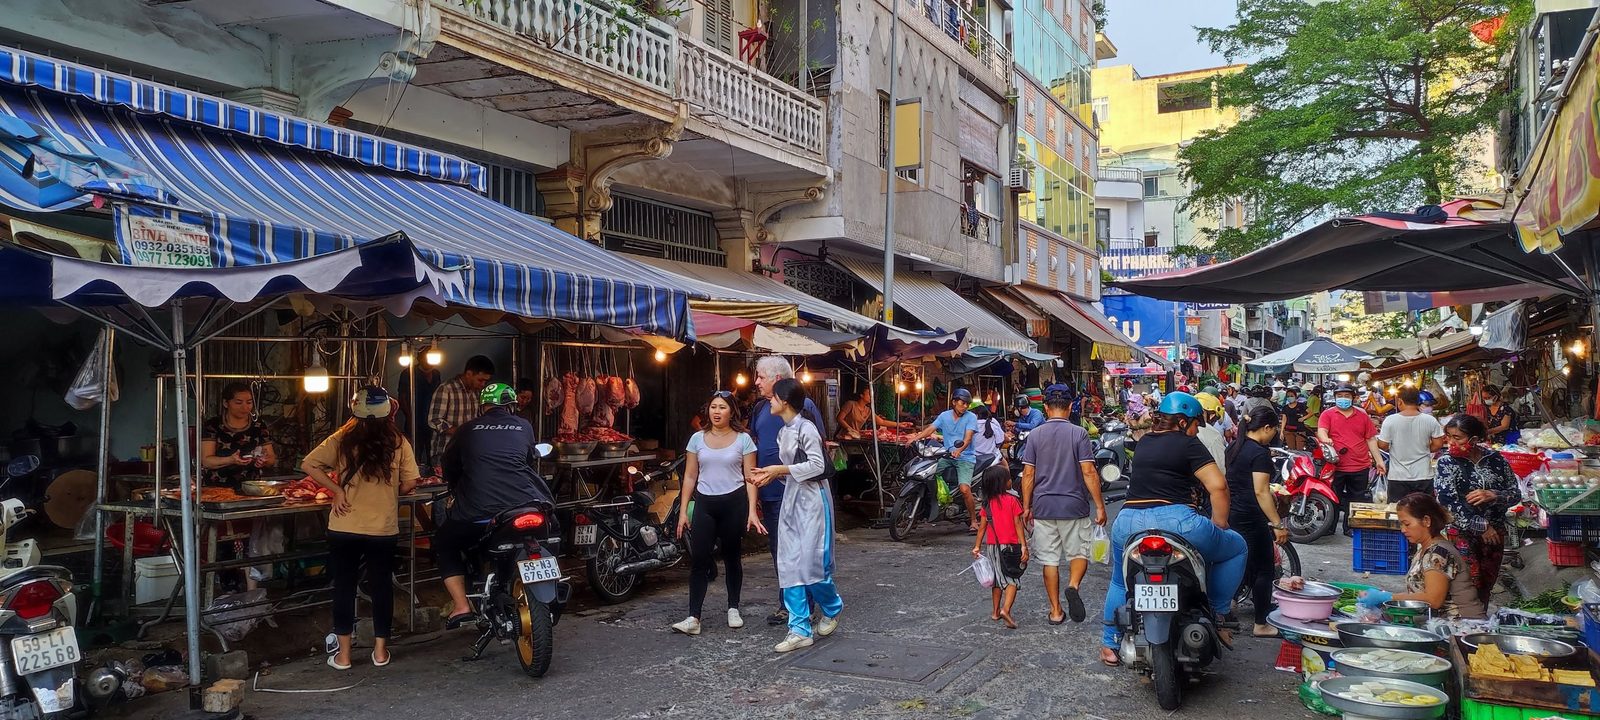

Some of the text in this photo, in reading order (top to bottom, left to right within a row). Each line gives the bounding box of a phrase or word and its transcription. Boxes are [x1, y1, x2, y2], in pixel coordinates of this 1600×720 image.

[134, 241, 209, 255] 0932.035153
[136, 250, 212, 268] 0977.123091
[523, 568, 558, 582] 676.66
[1141, 586, 1171, 597] 59-U1
[1137, 598, 1177, 609] 411.66
[22, 632, 65, 654] 59-L1
[20, 645, 76, 672] 225.68
